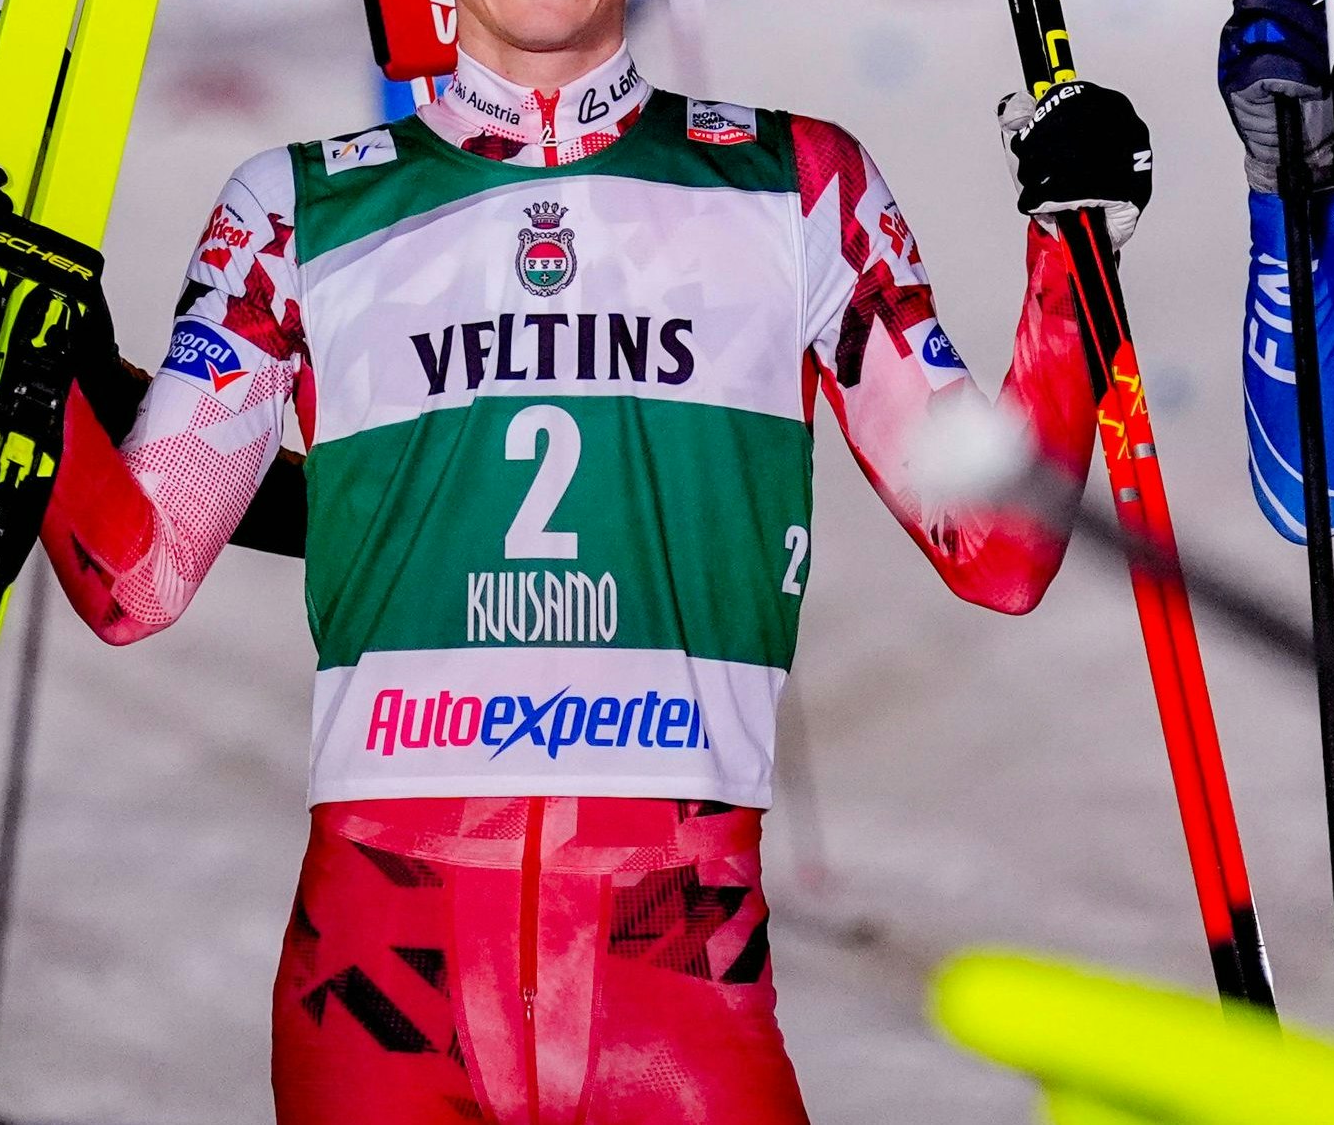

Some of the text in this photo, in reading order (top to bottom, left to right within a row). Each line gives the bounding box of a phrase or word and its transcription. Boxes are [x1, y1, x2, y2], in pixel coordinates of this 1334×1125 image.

[467, 91, 521, 126] Austria
[409, 312, 695, 395] VELTINS
[504, 404, 581, 560] 2
[782, 525, 809, 597] 2
[467, 570, 618, 643] KUUSAMO
